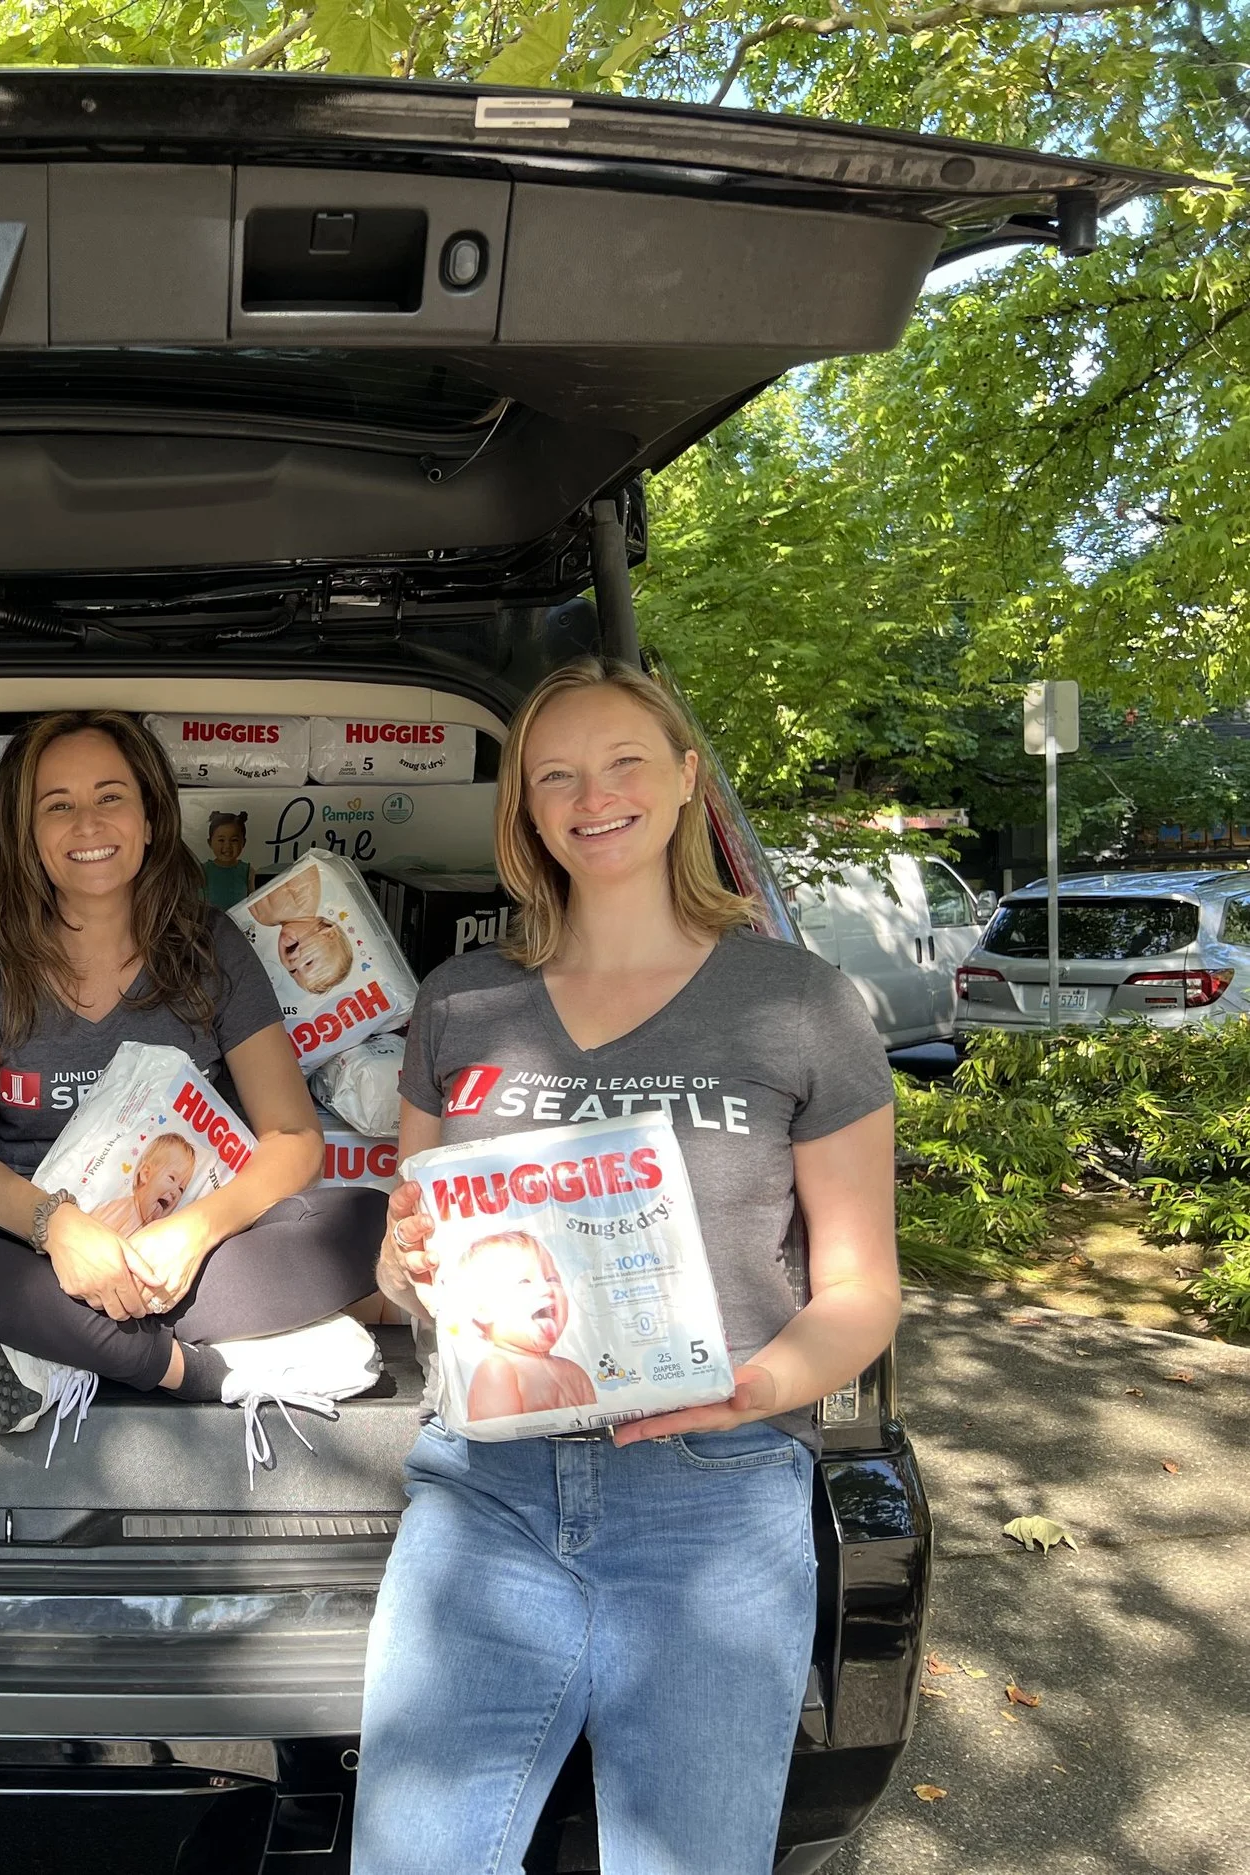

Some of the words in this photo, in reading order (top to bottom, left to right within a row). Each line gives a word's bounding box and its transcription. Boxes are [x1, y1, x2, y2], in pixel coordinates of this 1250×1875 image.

[183, 721, 279, 744] HUGGIES
[346, 724, 445, 744] HUGGIES
[198, 764, 208, 776] 5
[234, 766, 253, 778] snug
[262, 767, 277, 777] dry
[362, 757, 374, 771] 5
[398, 758, 420, 771] snug
[428, 758, 443, 768] dry
[390, 797, 403, 809] #1
[322, 806, 374, 823] Pampers
[508, 1071, 587, 1090] JUNIOR
[595, 1076, 685, 1091] LEAGUE
[692, 1077, 720, 1090] OF
[494, 1087, 751, 1135] SEATTLE
[88, 1147, 112, 1176] Project
[432, 1147, 663, 1222] HUGGIES
[566, 1218, 615, 1239] snug
[618, 1220, 635, 1235] &
[637, 1202, 670, 1229] dry
[615, 1251, 661, 1271] 100%
[658, 1353, 672, 1363] 25
[690, 1340, 709, 1364] 5
[652, 1371, 685, 1382] COUCHES
[653, 1363, 681, 1373] DIAPERS
